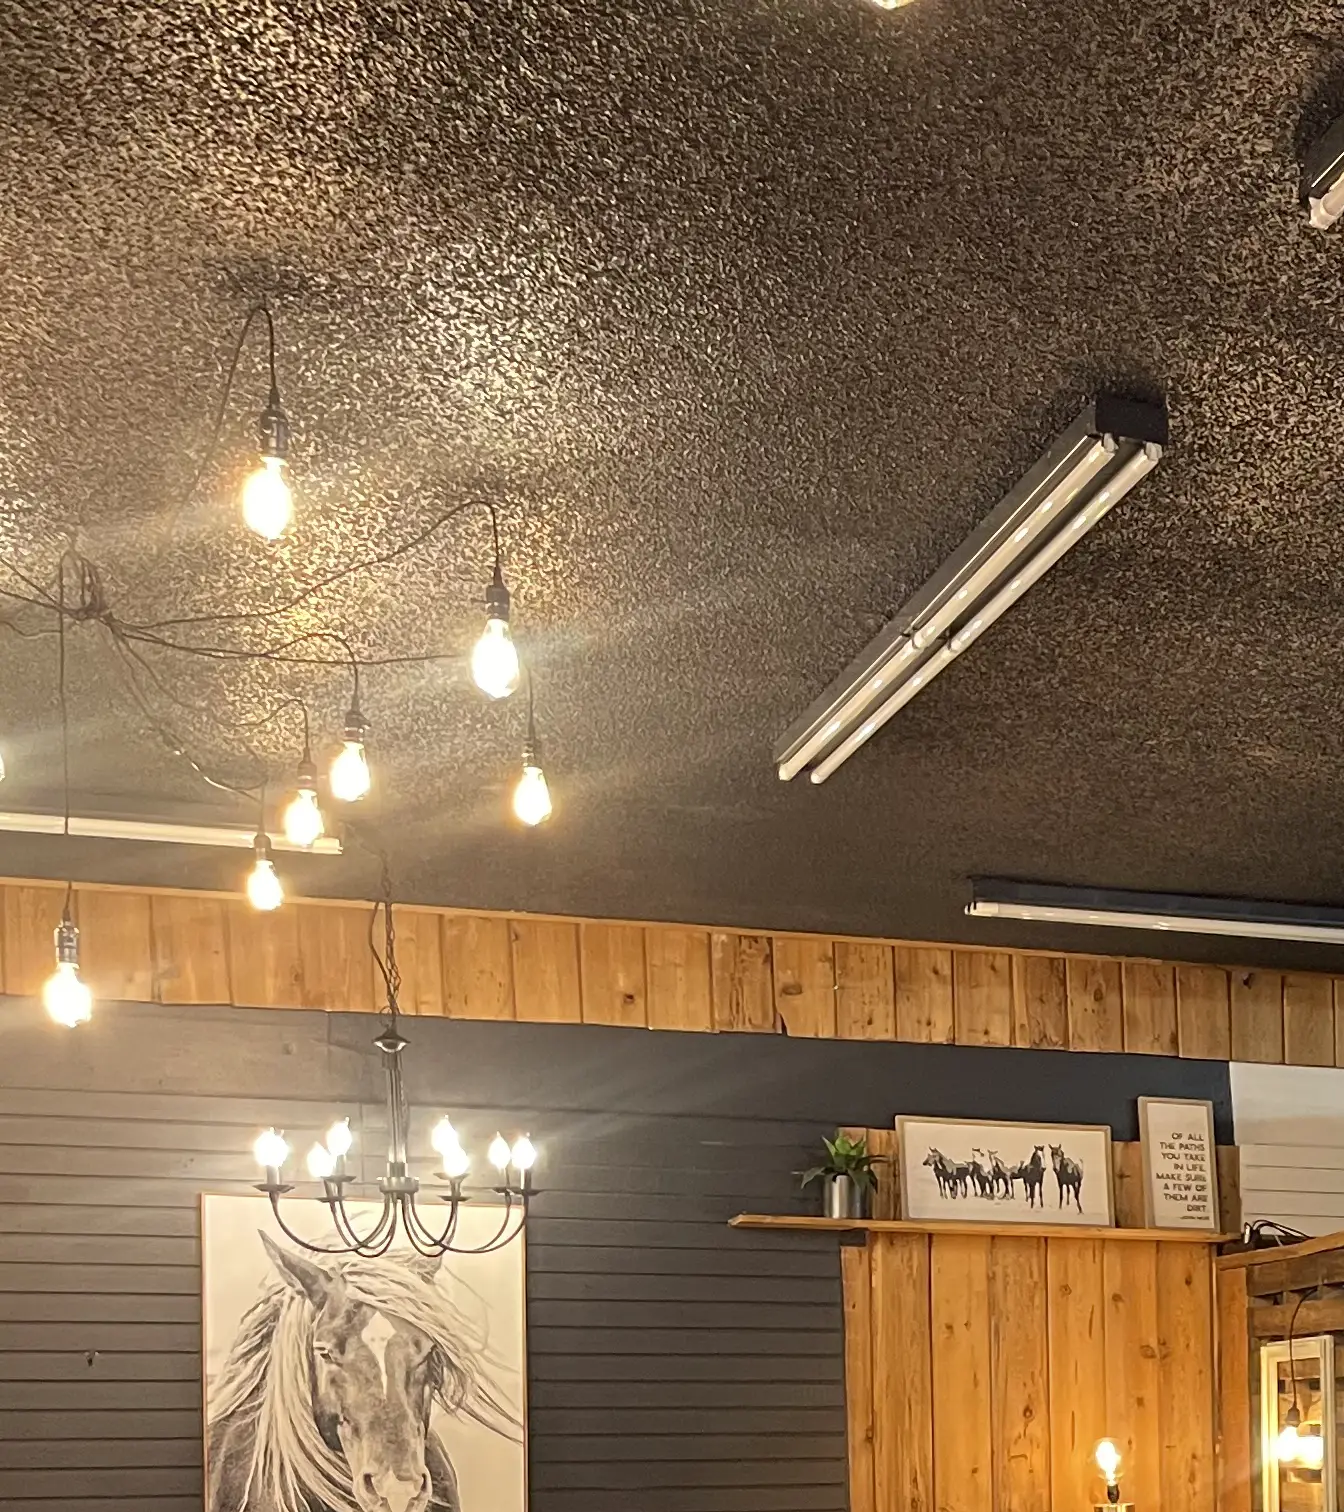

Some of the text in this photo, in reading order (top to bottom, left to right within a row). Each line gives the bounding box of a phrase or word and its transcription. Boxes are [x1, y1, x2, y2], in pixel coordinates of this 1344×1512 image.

[1171, 1132, 1204, 1141] OF ALL
[1160, 1142, 1205, 1151] THE PATHS
[1161, 1152, 1205, 1162] YOU TAKE
[1156, 1172, 1182, 1181] MAKE
[1173, 1183, 1192, 1191] FEW
[1195, 1184, 1206, 1192] OF
[1164, 1193, 1208, 1202] THEM ARE
